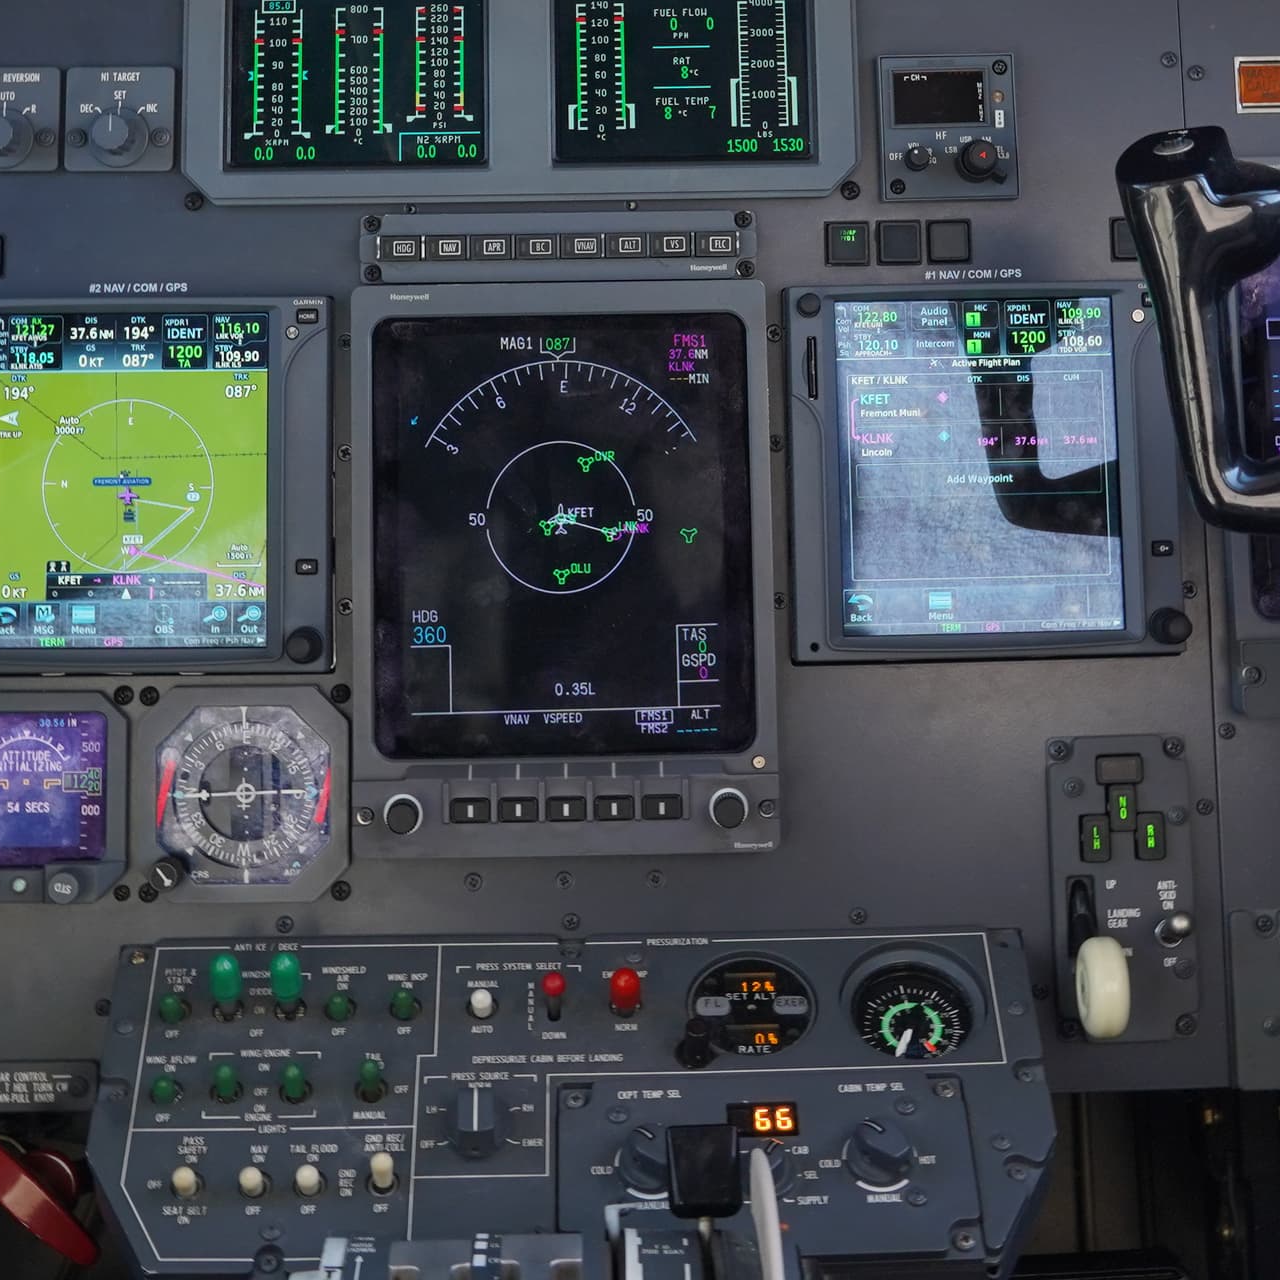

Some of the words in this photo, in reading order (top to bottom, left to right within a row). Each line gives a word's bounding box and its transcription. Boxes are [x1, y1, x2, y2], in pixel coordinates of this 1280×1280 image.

[268, 2, 291, 10] 85.0
[350, 5, 368, 13] 800
[653, 8, 677, 17] FUEL
[682, 8, 707, 16] FLOW
[269, 17, 287, 25] 110
[750, 28, 774, 37] 3000
[269, 39, 287, 47] 100
[430, 37, 448, 45] 140
[673, 57, 690, 65] RAT
[750, 60, 775, 68] 2000
[350, 66, 368, 74] 600
[3, 73, 40, 83] REVERSION
[101, 72, 110, 81] N1
[113, 72, 140, 82] TARGET
[114, 91, 127, 100] SET
[751, 90, 776, 98] 1000
[656, 97, 680, 106] FUEL
[685, 96, 710, 105] TEMP
[80, 104, 93, 113] DEC
[146, 104, 158, 113] INC
[416, 136, 429, 144] N2
[936, 131, 947, 140] HF
[727, 139, 758, 152] 1500
[773, 138, 804, 152] 1530
[397, 242, 412, 254] HDG
[443, 242, 457, 253] NAV
[487, 242, 501, 253] APR
[536, 241, 545, 252] BC
[577, 240, 593, 251] VNAV
[624, 239, 636, 251] ALT
[670, 239, 679, 250] VS
[715, 238, 726, 250] FLC
[690, 264, 728, 273] Honeywell
[925, 270, 936, 280] #1
[939, 269, 960, 280] NAV
[968, 269, 993, 279] COM
[1000, 269, 1022, 279] GPS
[89, 283, 101, 293] #2
[103, 283, 125, 293] NAV
[133, 283, 158, 293] COM
[165, 282, 188, 293] GPS
[857, 311, 897, 323] 122.80
[921, 307, 948, 316] Audio
[922, 317, 947, 326] Panel
[1010, 314, 1045, 325] IDENT
[70, 328, 97, 340] 37.6
[99, 330, 114, 339] NM
[124, 326, 155, 340] 194°
[167, 327, 203, 340] IDENT
[1011, 331, 1046, 344] 1200
[500, 337, 533, 350] MAG1
[545, 338, 570, 350] 087
[674, 335, 706, 347] FMS1
[916, 340, 954, 348] Intercom
[168, 345, 202, 359] 1200
[669, 349, 709, 360] 37.6NM
[123, 354, 154, 368] 087°
[669, 361, 695, 372] KLNK
[952, 359, 977, 368] Active
[979, 358, 1001, 369] Flight
[1003, 358, 1021, 367] Plan
[860, 409, 898, 417] Fremont
[900, 408, 921, 417] Muni
[862, 448, 892, 457] Lincoln
[947, 473, 965, 483] Add
[967, 473, 1013, 485] Waypoint
[568, 507, 594, 518] KFET
[636, 509, 654, 522] 50
[469, 513, 486, 526] 50
[571, 563, 591, 574] OLU
[58, 576, 82, 585] KFET
[112, 575, 141, 585] KLNK
[412, 610, 438, 623] HDG
[33, 625, 54, 634] MSG
[71, 625, 96, 634] Menu
[155, 624, 174, 634] OBS
[413, 626, 447, 643] 360
[682, 628, 707, 641] TAS
[681, 654, 716, 667] GSPD
[504, 714, 530, 725] VNAV
[543, 713, 583, 724] VSPEED
[640, 710, 668, 721] FMS1
[691, 709, 709, 720] ALT
[640, 723, 668, 733] FMS2
[2, 751, 52, 762] ATTITUDE
[7, 802, 20, 813] 54
[25, 802, 50, 813] SECS
[1105, 880, 1117, 889] UP
[1107, 909, 1141, 919] LANDING
[1107, 919, 1128, 929] GEAR
[646, 938, 708, 946] PRESSURIZATION
[738, 1045, 772, 1054] RATE
[754, 1108, 793, 1131] 66
